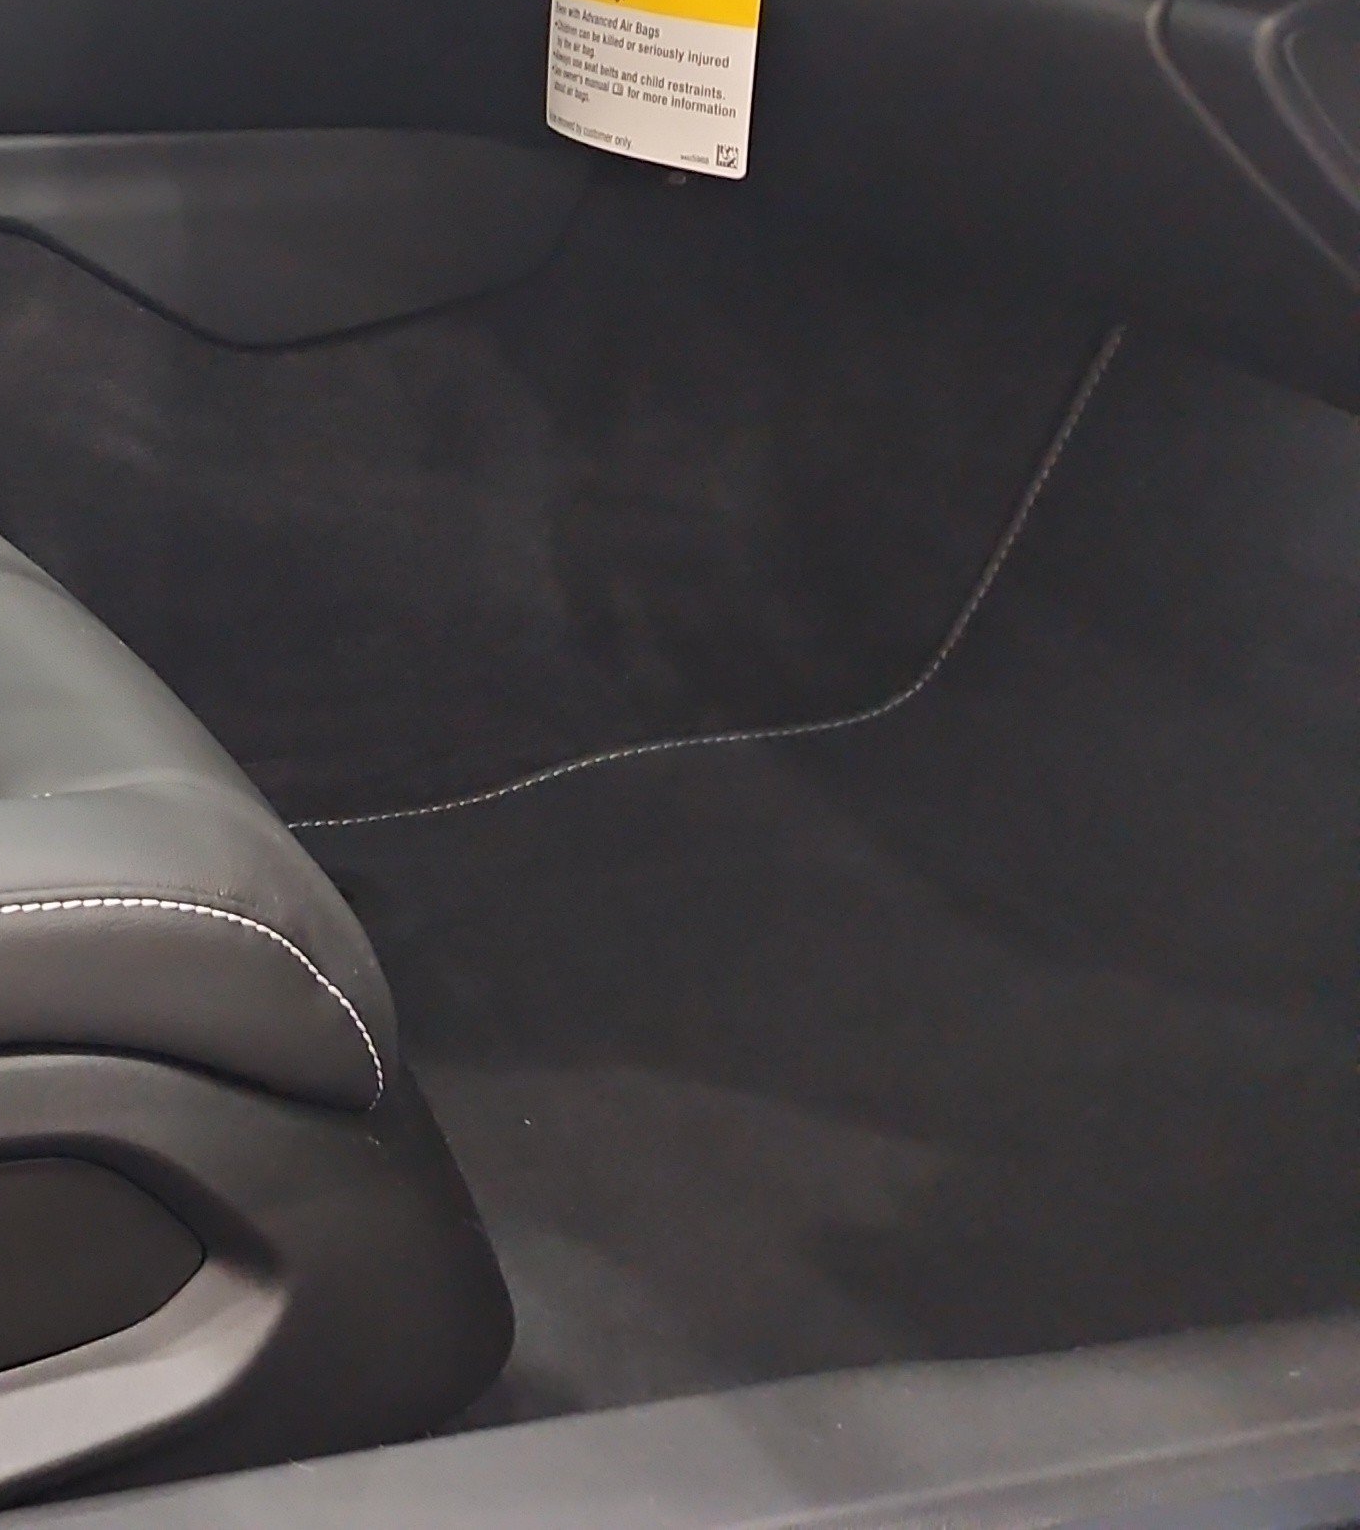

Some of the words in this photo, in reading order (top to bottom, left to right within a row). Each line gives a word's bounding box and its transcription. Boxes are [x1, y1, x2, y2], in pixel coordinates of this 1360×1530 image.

[582, 9, 618, 30] Advanced
[620, 18, 634, 32] Air
[636, 21, 660, 40] Bags
[579, 29, 590, 40] can
[592, 30, 601, 43] be
[602, 33, 624, 49] killed
[626, 40, 636, 52] or
[638, 42, 685, 64] seriously
[688, 50, 730, 69] injured
[584, 60, 599, 75] seat
[600, 64, 620, 80] belts
[621, 68, 638, 84] and
[640, 73, 665, 90] child
[668, 80, 726, 100] restraints.
[628, 86, 640, 100] for
[642, 92, 668, 106] more
[671, 96, 737, 119] information
